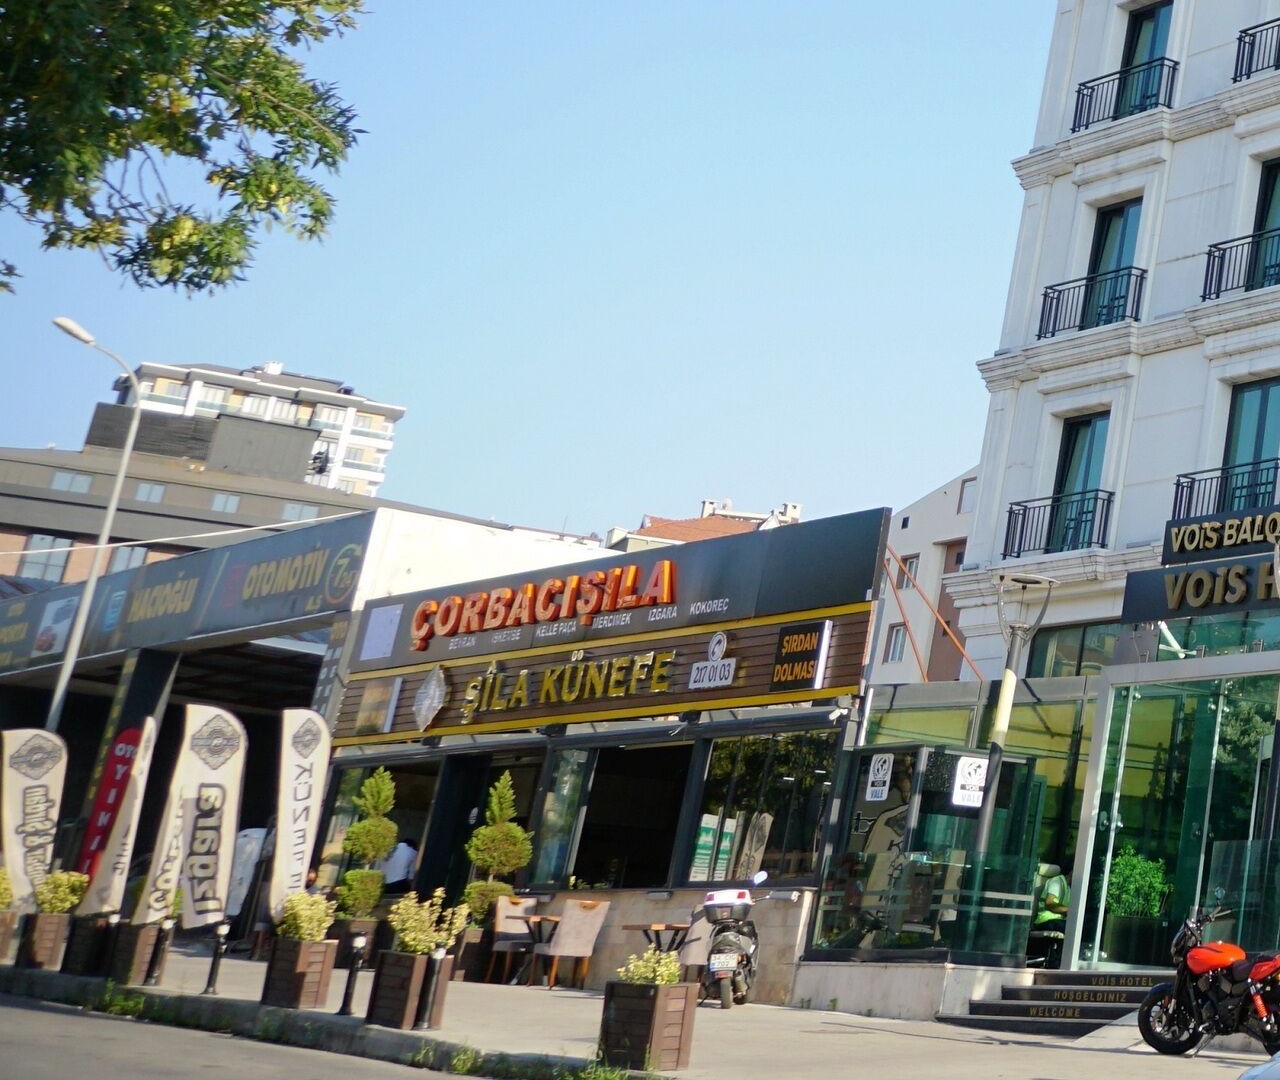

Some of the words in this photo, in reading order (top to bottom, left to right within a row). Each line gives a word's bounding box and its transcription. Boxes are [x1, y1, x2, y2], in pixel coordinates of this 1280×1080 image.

[535, 623, 558, 637] KELLE
[689, 598, 730, 616] KOKOREÇ
[781, 632, 819, 656] ŞIRDAN
[539, 650, 677, 704] KÜNEFE
[693, 665, 708, 684] 217
[709, 664, 718, 682] 01
[718, 663, 731, 681] 03
[773, 660, 818, 682] DOLMASI
[1119, 977, 1154, 987] HOTEL
[1029, 1008, 1081, 1017] WELCOME
